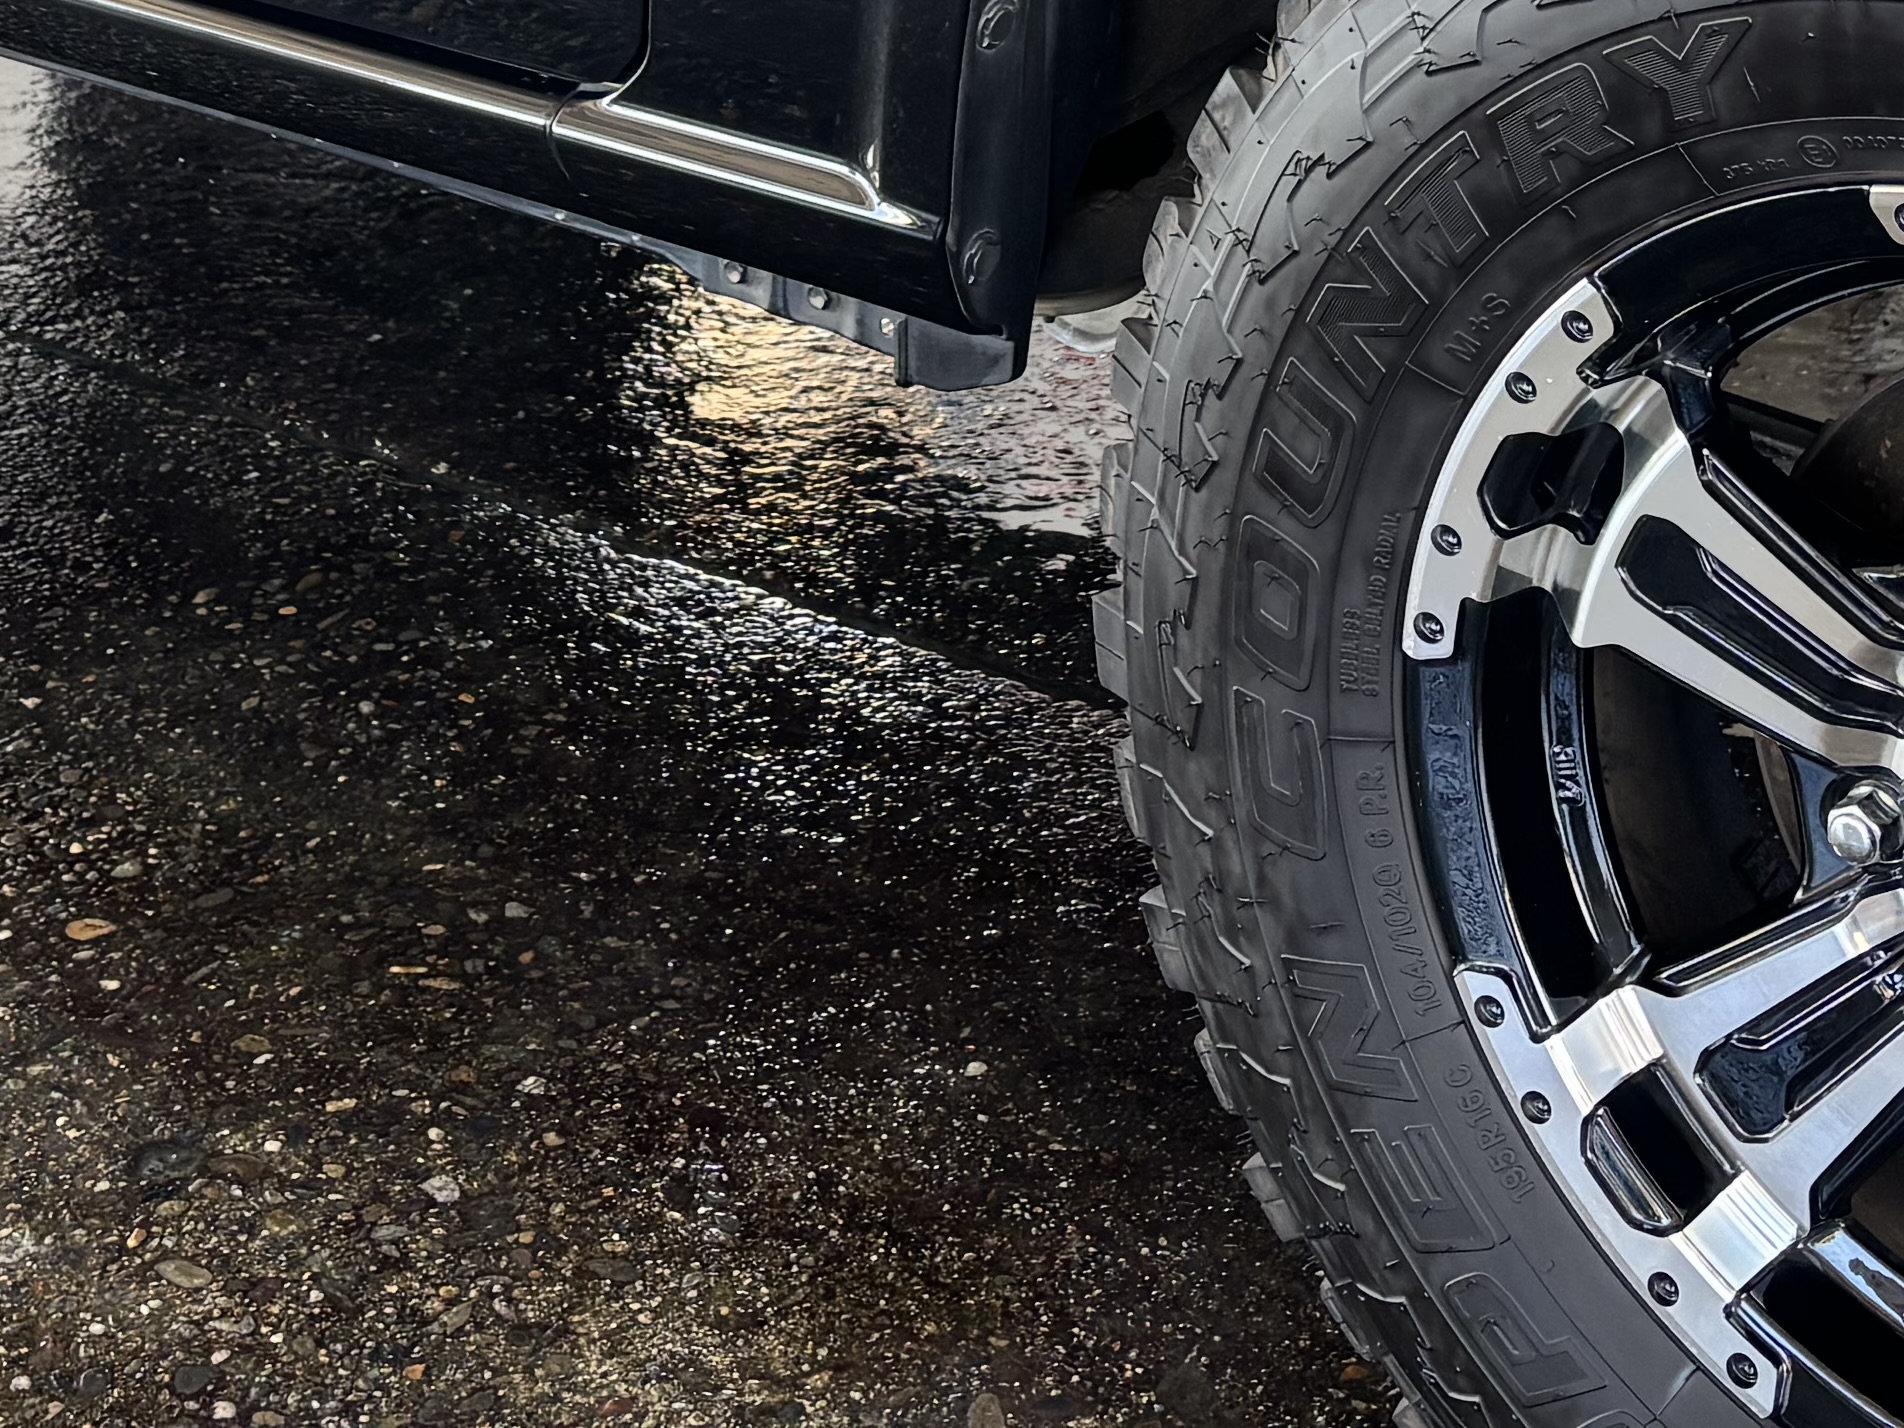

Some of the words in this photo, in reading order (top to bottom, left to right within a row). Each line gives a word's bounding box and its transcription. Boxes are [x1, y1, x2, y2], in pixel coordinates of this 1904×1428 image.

[1229, 16, 1756, 860] COUNTRY
[1444, 290, 1510, 366] M+S
[1281, 952, 1646, 1428] PEN
